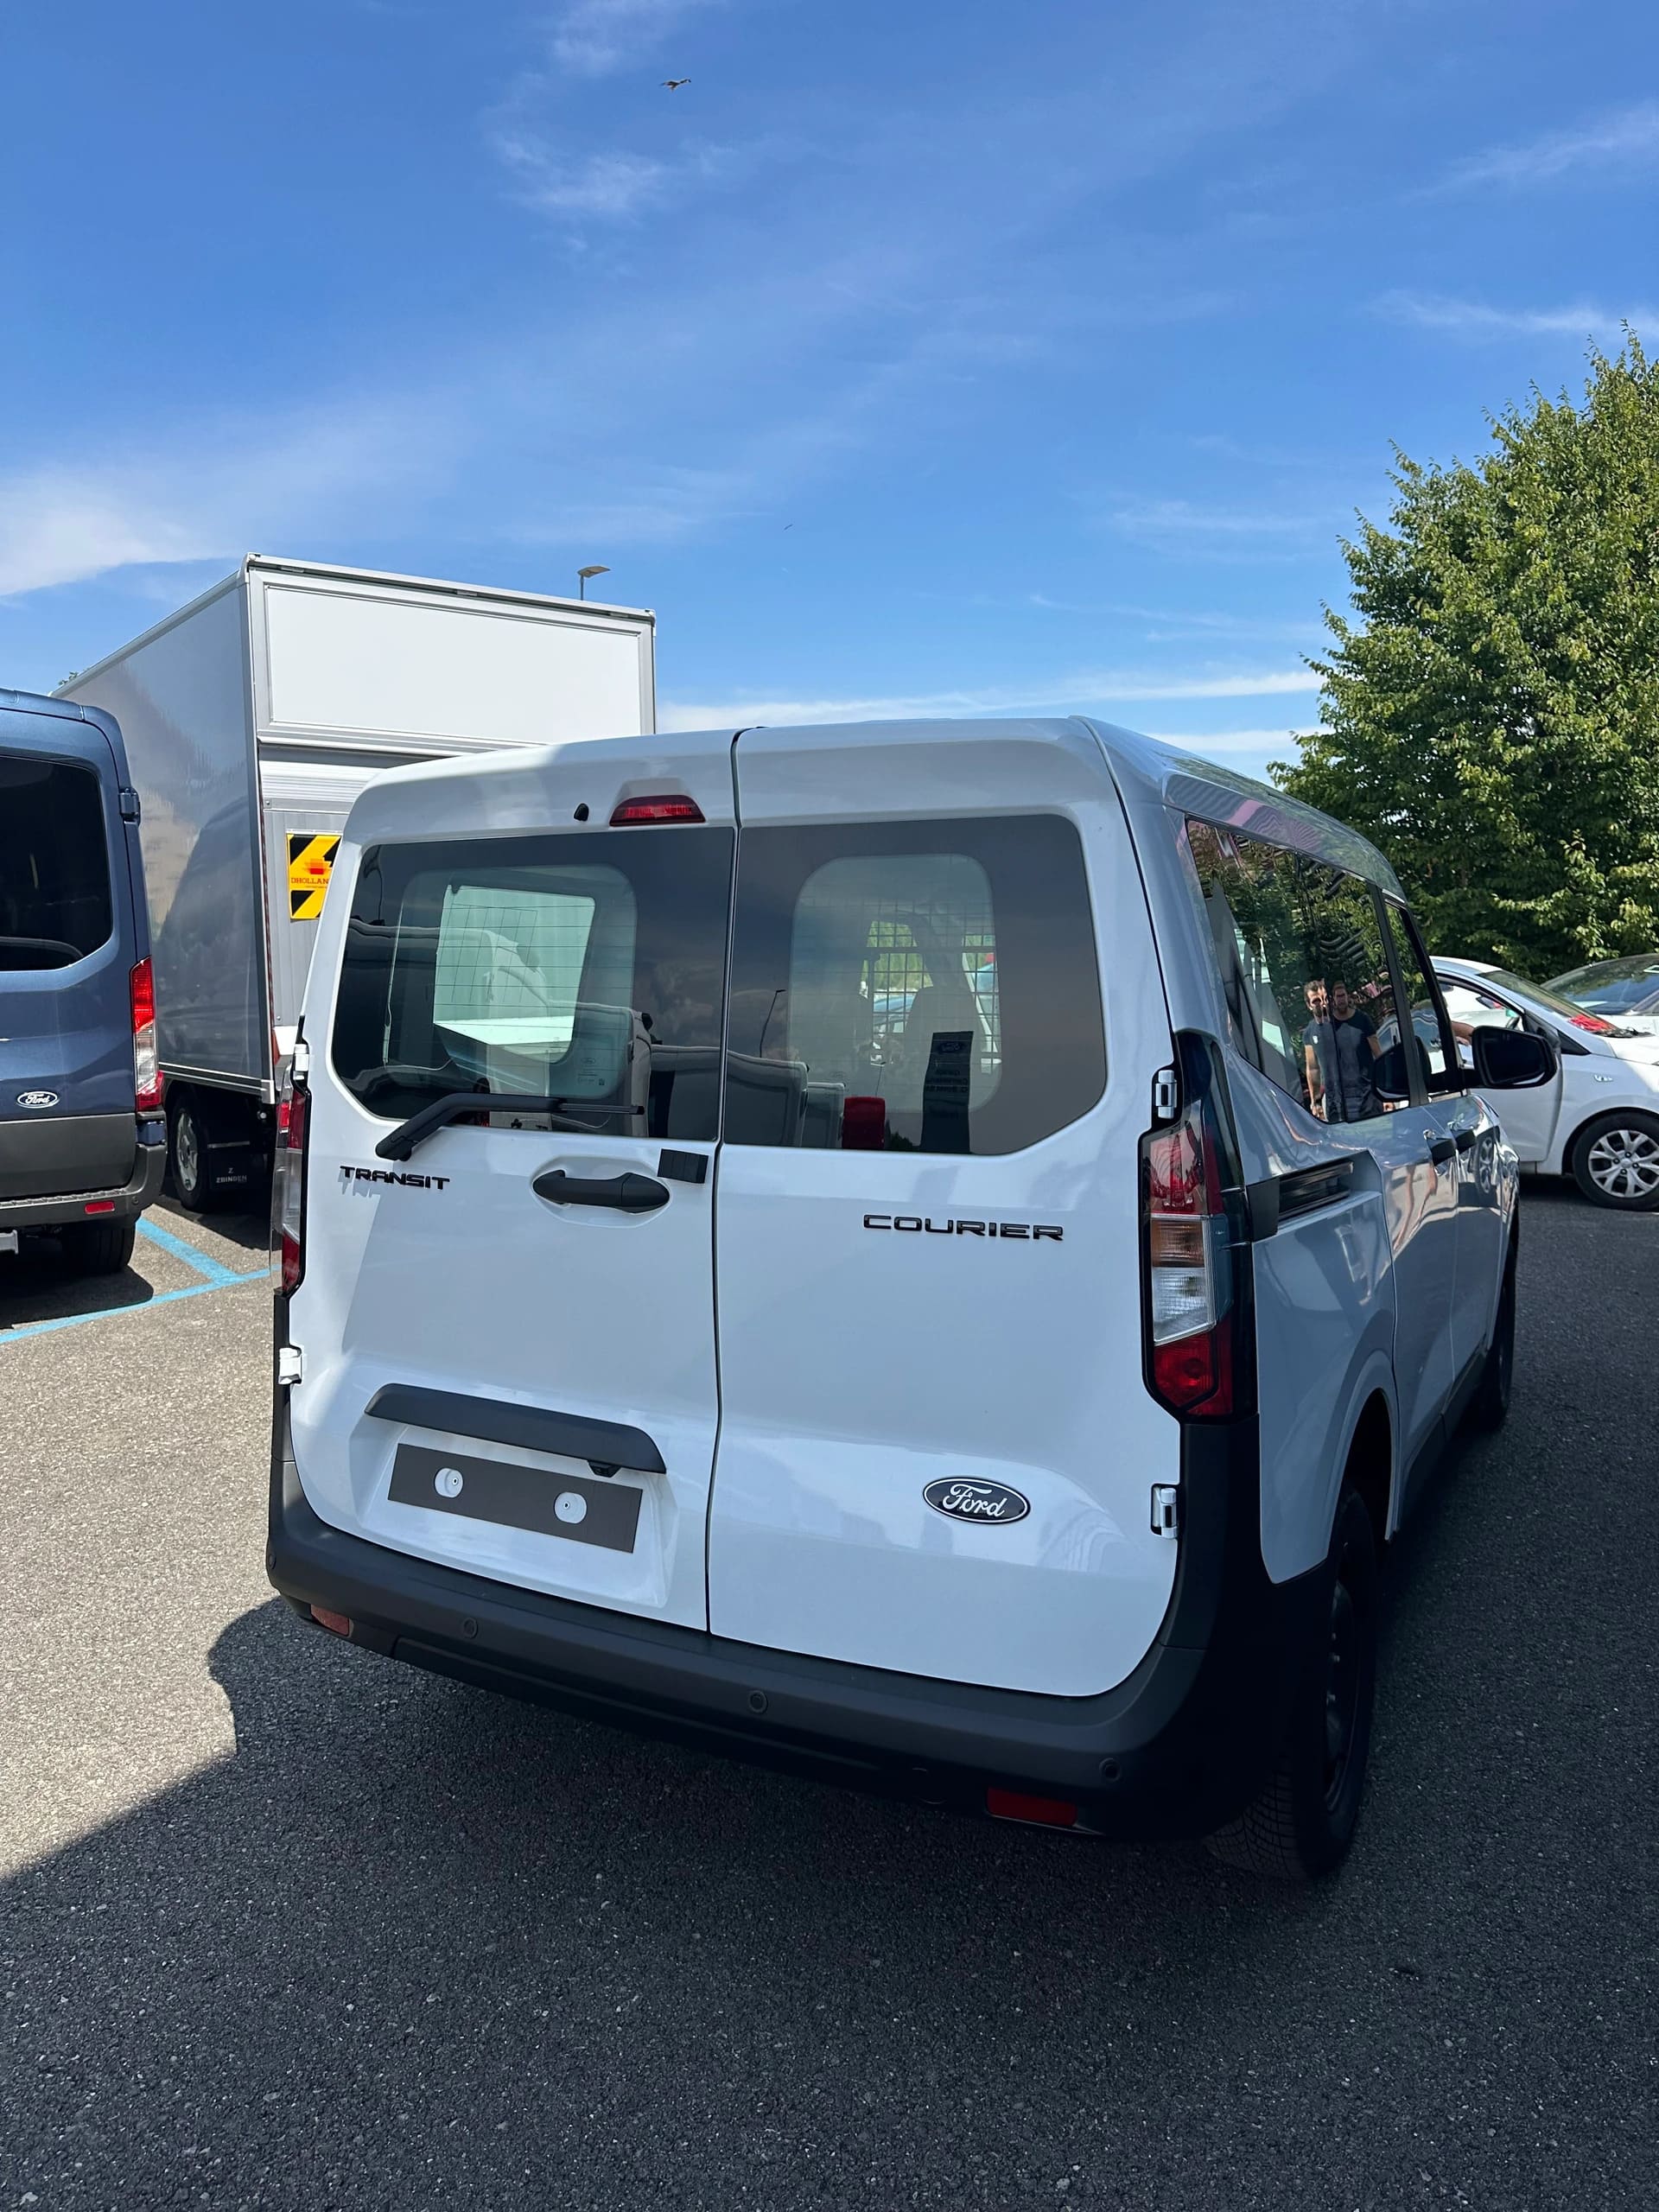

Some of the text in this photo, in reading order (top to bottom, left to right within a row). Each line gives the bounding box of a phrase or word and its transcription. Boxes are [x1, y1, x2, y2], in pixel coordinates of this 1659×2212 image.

[25, 1093, 51, 1104] Ford
[340, 1165, 450, 1190] TRANSIT
[863, 1214, 1064, 1241] COURIER
[942, 1484, 1007, 1517] Ford
